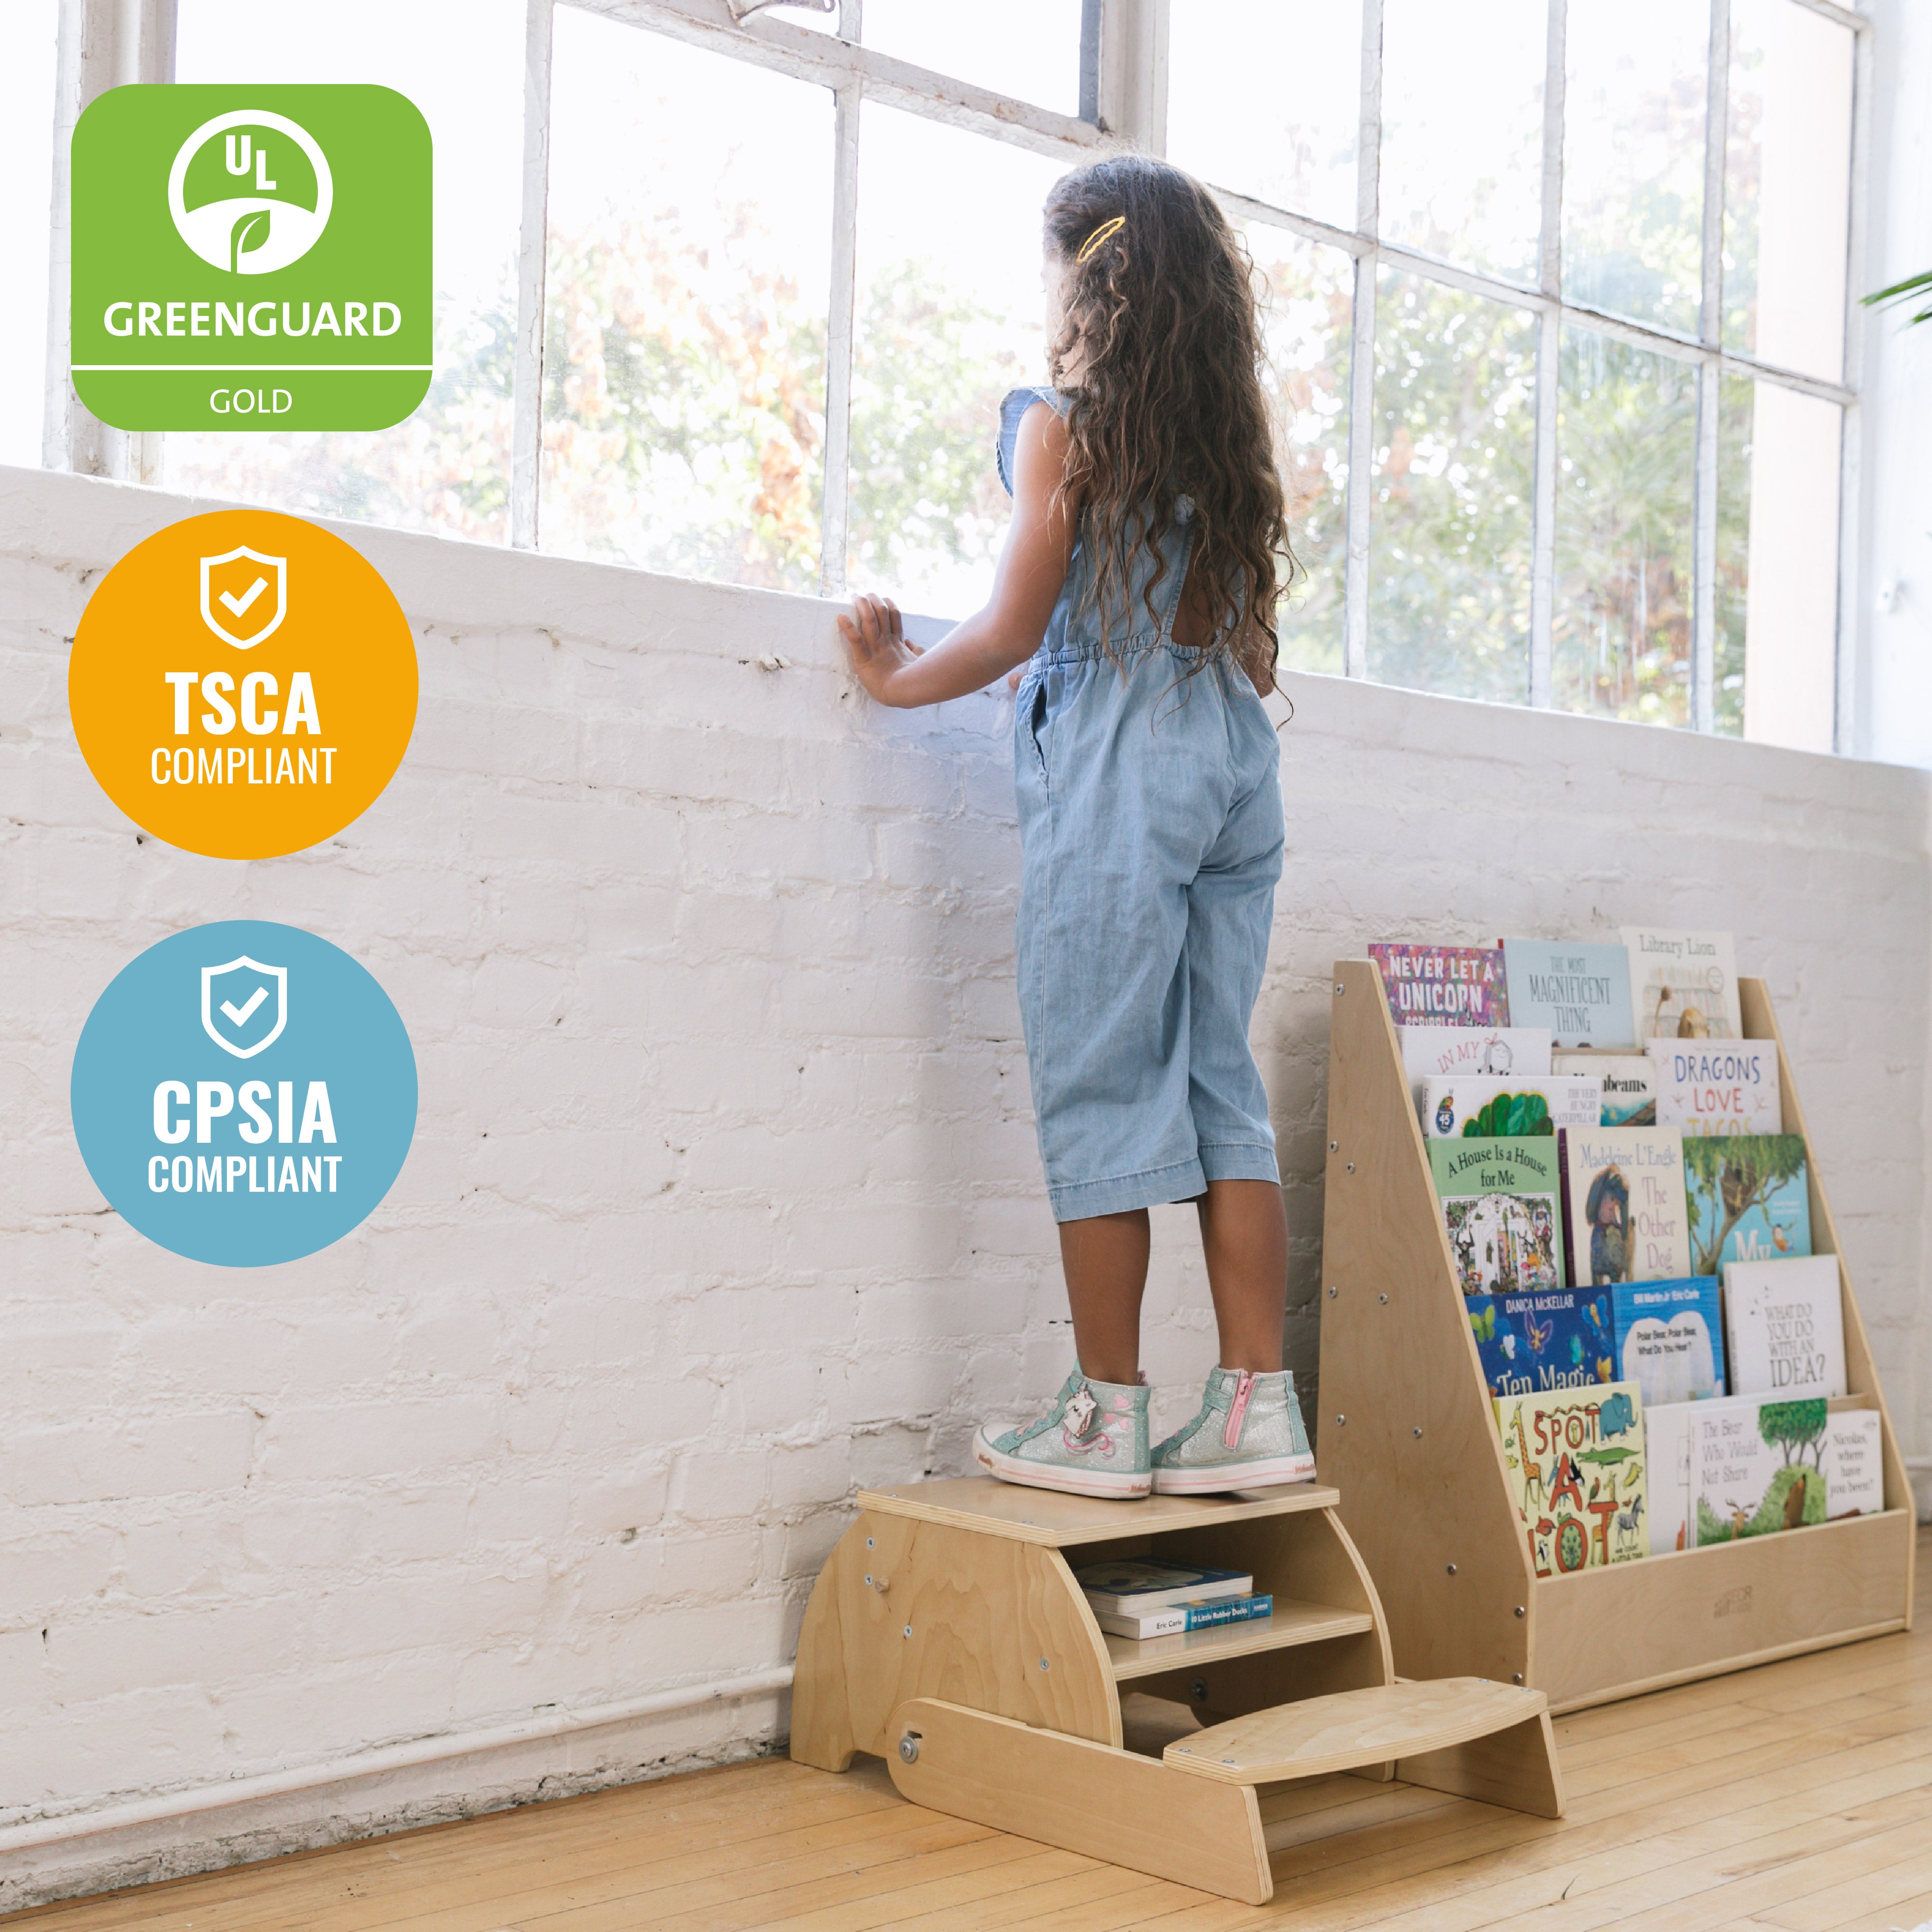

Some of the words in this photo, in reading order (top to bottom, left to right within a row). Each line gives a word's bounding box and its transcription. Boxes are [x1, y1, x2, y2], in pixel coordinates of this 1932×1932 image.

[1639, 934, 1683, 960] Library
[1686, 937, 1716, 956] Lion
[1390, 955, 1444, 978] NEVER
[1450, 957, 1479, 980] LET
[1483, 962, 1494, 982] A
[1399, 982, 1482, 1013] UNICORN
[1529, 974, 1611, 1005] MAGNIFICENT
[1553, 1006, 1591, 1033] THING
[1437, 1049, 1454, 1074] IN
[1457, 1041, 1480, 1062] MY
[1675, 1055, 1761, 1084] DRAGONS
[1694, 1088, 1744, 1113] LOVE
[1439, 1114, 1450, 1126] 45
[1449, 1161, 1458, 1179] A
[1457, 1149, 1492, 1171] House
[1494, 1144, 1504, 1161] Is
[1506, 1151, 1512, 1161] a
[1514, 1147, 1547, 1176] House
[1481, 1168, 1496, 1187] for
[1497, 1170, 1515, 1186] Me
[1642, 1176, 1667, 1207] The
[1638, 1208, 1676, 1237] Other
[1506, 1298, 1534, 1314] DANICA
[1496, 1369, 1533, 1396] Ten
[1770, 1353, 1826, 1388] IDEA?
[1534, 1408, 1602, 1456] SPOT
[1702, 1421, 1719, 1439] The
[1721, 1419, 1743, 1437] Bear
[1702, 1443, 1725, 1463] Who
[1727, 1437, 1759, 1459] Would
[1548, 1452, 1583, 1512] A
[1527, 1501, 1619, 1578] LOT
[1156, 1621, 1167, 1630] Eric
[1168, 1619, 1183, 1627] Carle
[1198, 1614, 1212, 1622] Little
[1213, 1610, 1231, 1619] Rubber
[1232, 1607, 1248, 1616] Ducks
